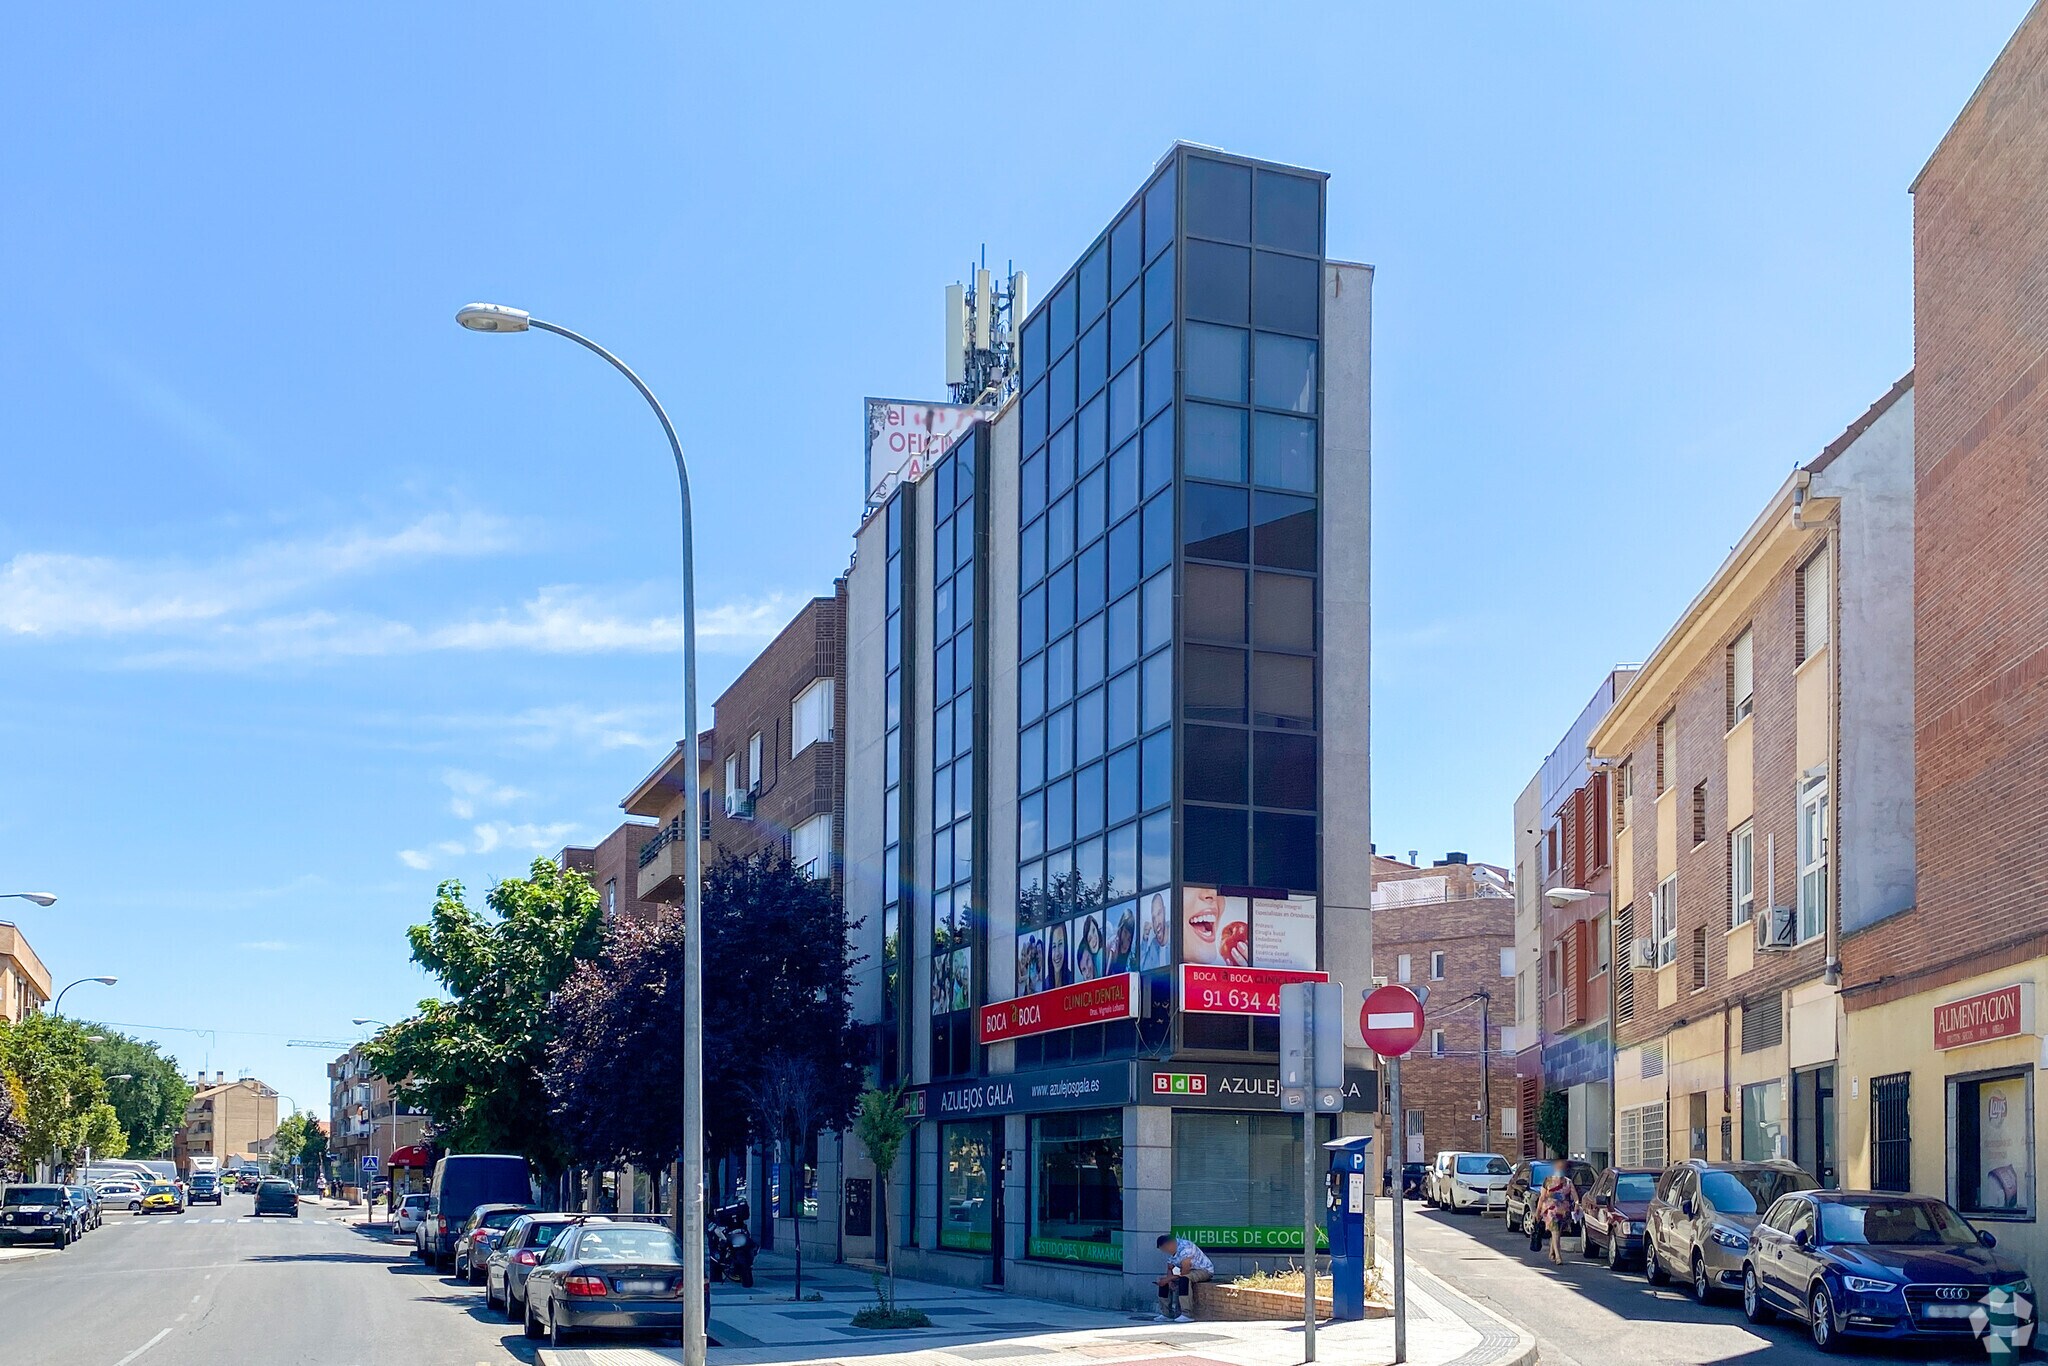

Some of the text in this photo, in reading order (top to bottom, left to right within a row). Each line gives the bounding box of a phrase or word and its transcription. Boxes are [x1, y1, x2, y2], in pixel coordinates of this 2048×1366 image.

[1193, 971, 1217, 982] BOCA
[1230, 973, 1253, 983] BOCA
[1063, 985, 1125, 1011] CLINICA DENTAL
[1203, 989, 1281, 1011] 91 634 4
[986, 1012, 1007, 1033] BOCA
[1018, 1004, 1041, 1027] BOCA
[1938, 992, 2015, 1034] ALIMENTACION
[1157, 1077, 1202, 1091] BdB
[940, 1083, 1014, 1112] AZULEJOS GALA
[1415, 1143, 1422, 1153] 3
[1354, 1154, 1363, 1169] P
[1175, 1230, 1328, 1245] MUEBLES DE COCIA
[1031, 1240, 1078, 1256] VESTIDORES
[1079, 1244, 1086, 1256] Y
